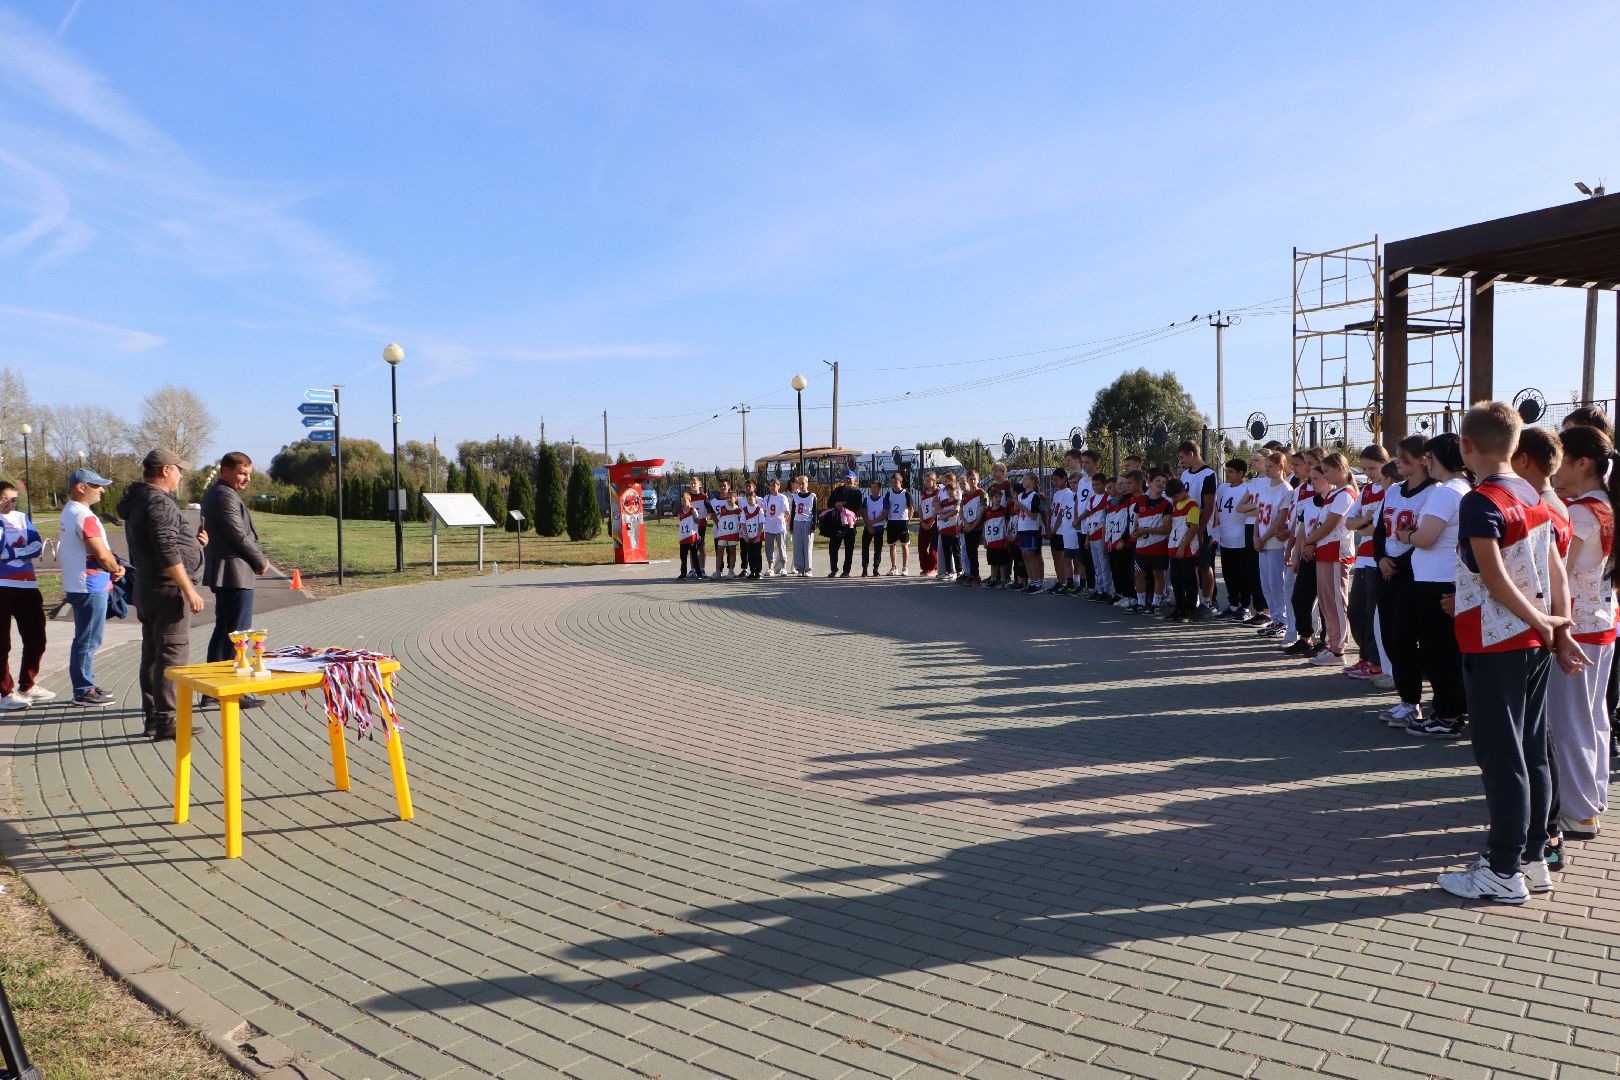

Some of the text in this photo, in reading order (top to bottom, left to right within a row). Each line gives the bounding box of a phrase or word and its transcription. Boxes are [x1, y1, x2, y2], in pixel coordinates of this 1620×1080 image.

[1081, 488, 1089, 502] 9
[769, 504, 776, 515] 9
[797, 503, 804, 514] 6
[893, 503, 900, 514] 2
[1258, 502, 1273, 526] 53
[723, 520, 734, 531] 10
[987, 525, 999, 536] 59
